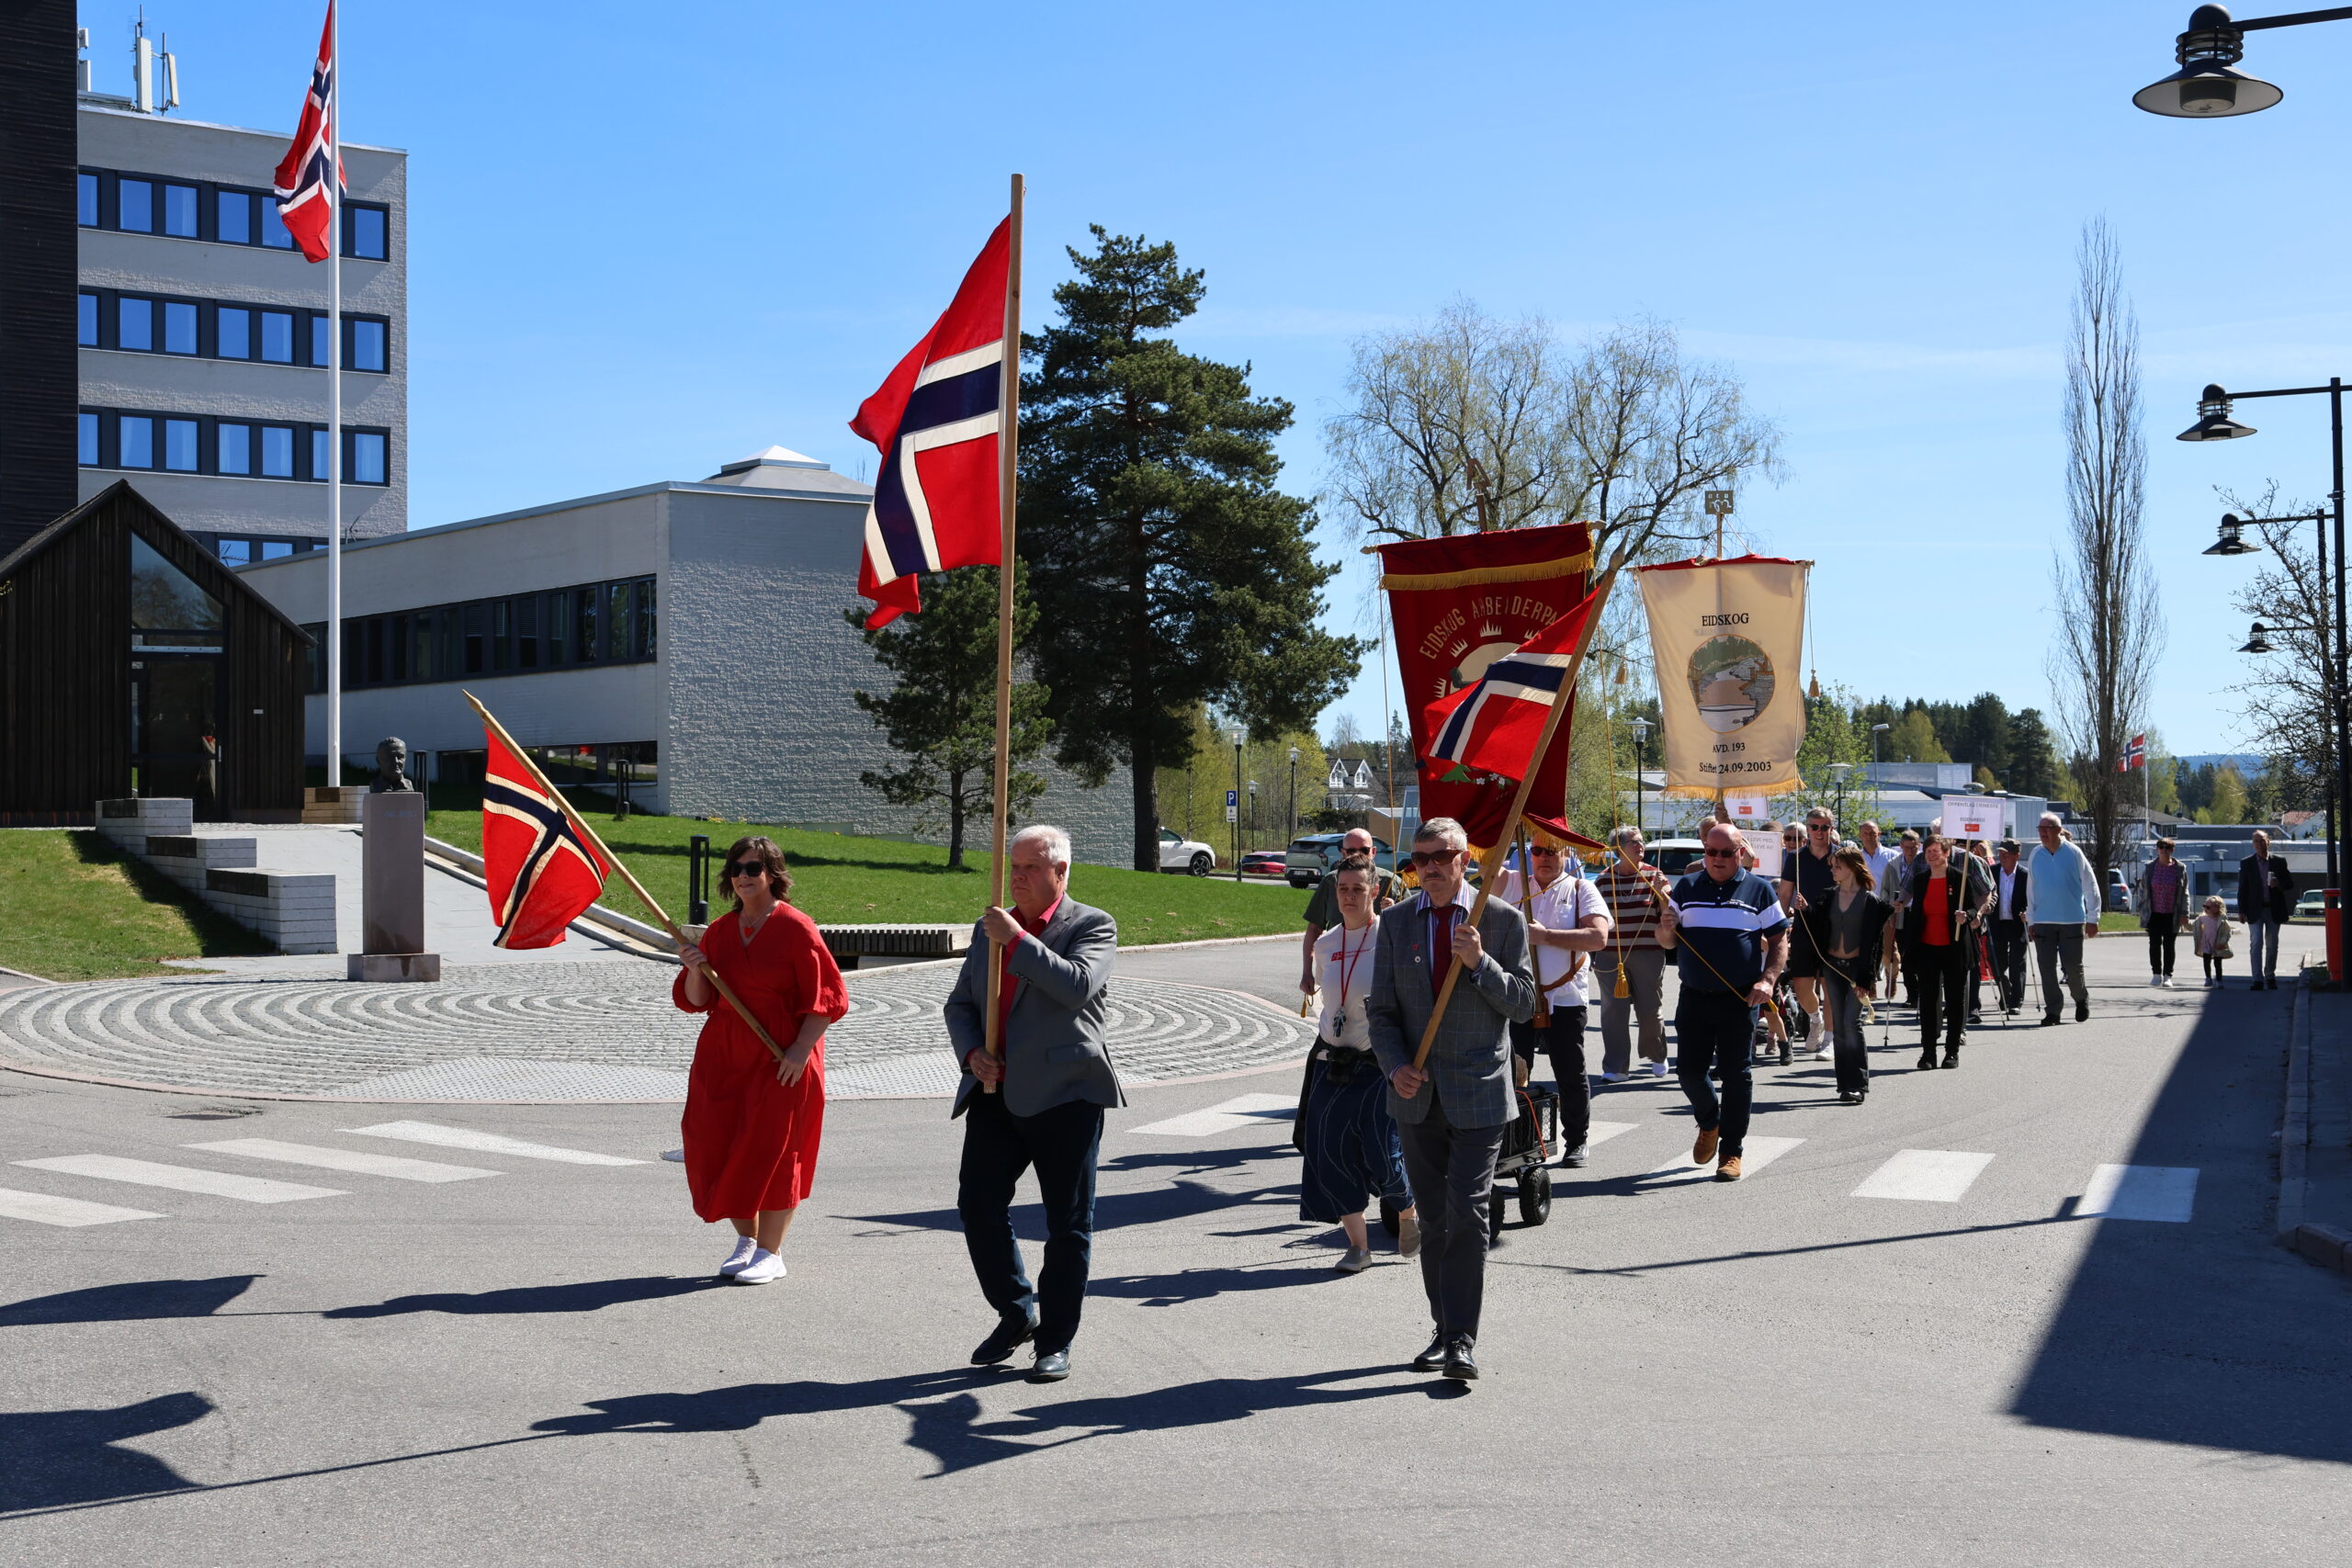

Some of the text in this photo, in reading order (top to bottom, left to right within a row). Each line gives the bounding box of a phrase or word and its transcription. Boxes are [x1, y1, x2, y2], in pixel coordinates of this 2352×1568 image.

[1702, 613, 1749, 626] EIDSKOG
[1419, 595, 1560, 660] EIDSKOG ARBEIDERPA
[1713, 742, 1746, 753] AVD. 193
[1718, 761, 1772, 774] 24.09.2003
[1228, 793, 1234, 804] P
